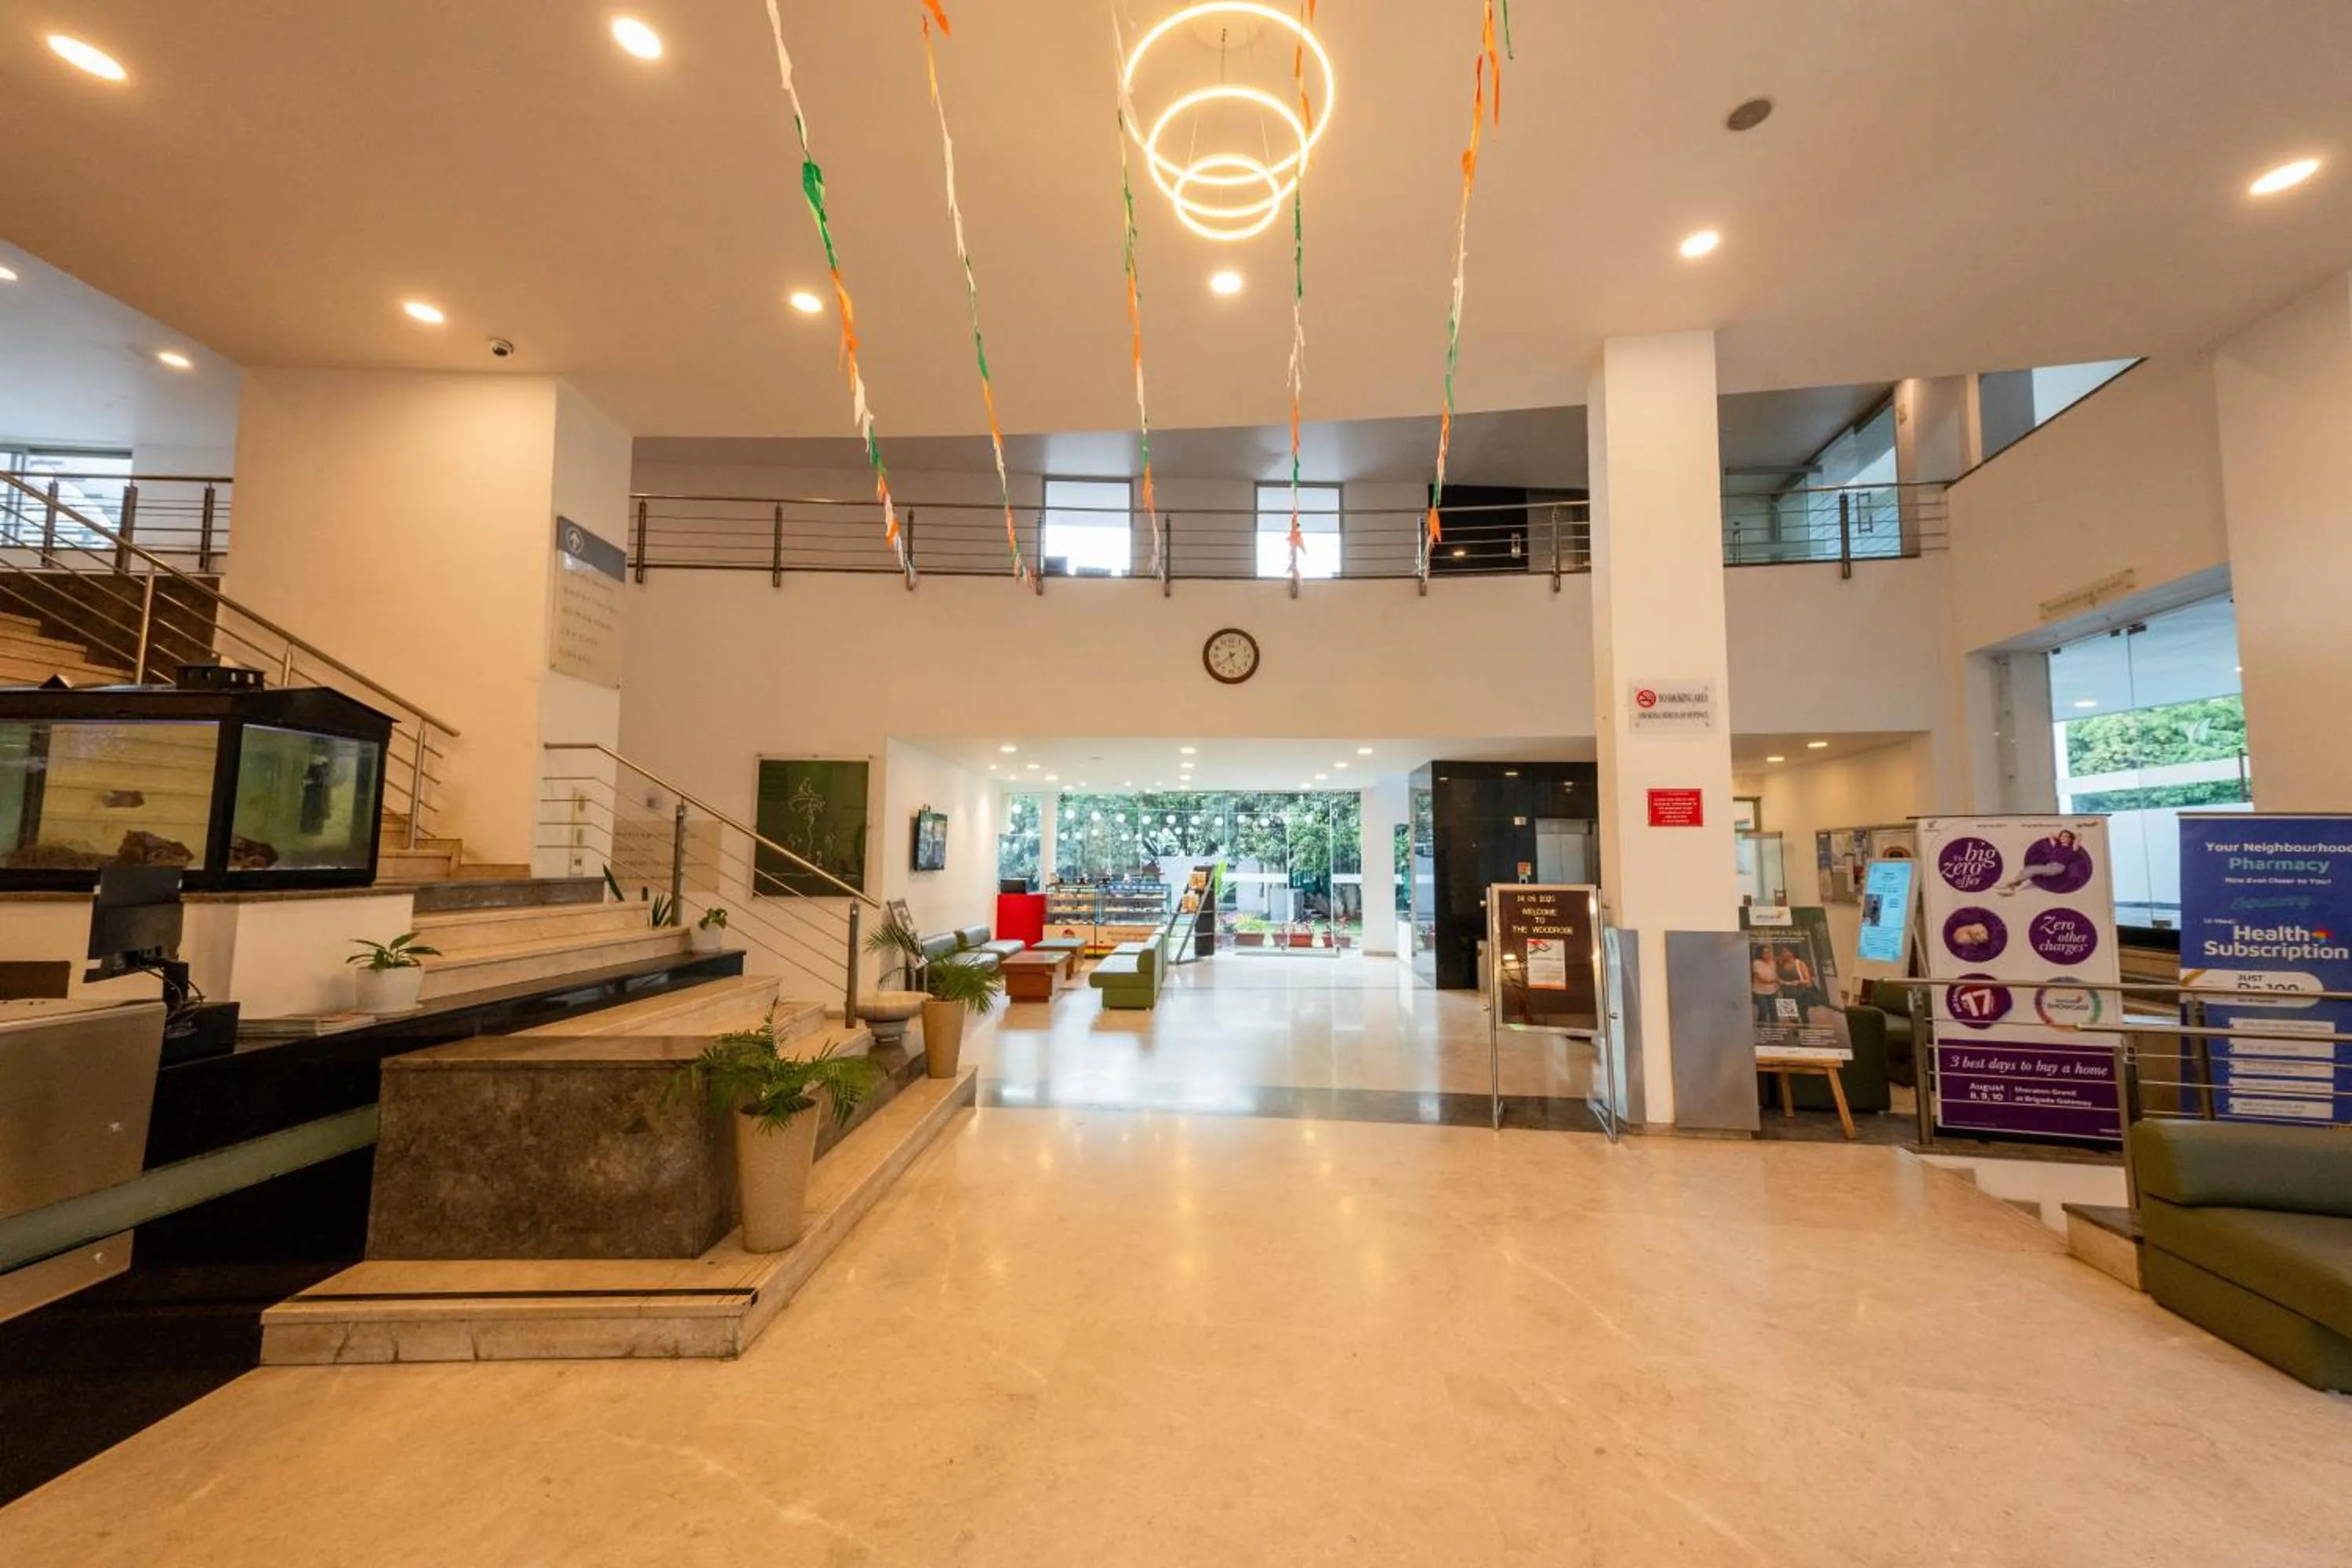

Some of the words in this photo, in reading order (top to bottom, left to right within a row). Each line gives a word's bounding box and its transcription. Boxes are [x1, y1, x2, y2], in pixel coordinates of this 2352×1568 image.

[1964, 841, 1997, 868] big
[2205, 842, 2240, 853] Your
[1941, 861, 1983, 879] zero
[2228, 858, 2331, 874] Pharmacy
[1955, 876, 1982, 888] offer
[1522, 908, 1558, 916] WELCOME
[2040, 916, 2076, 935] Zero
[2233, 925, 2310, 942] Health
[2057, 931, 2089, 942] other
[2204, 940, 2350, 962] Subscription
[1961, 988, 1992, 1017] 17
[1950, 1055, 1960, 1068] 3
[1962, 1057, 1986, 1069] best
[1988, 1058, 2016, 1073] days
[2020, 1059, 2031, 1071] to
[2036, 1060, 2058, 1076] buy
[2061, 1065, 2071, 1073] a
[2074, 1062, 2109, 1076] home
[1969, 1083, 2005, 1094] August
